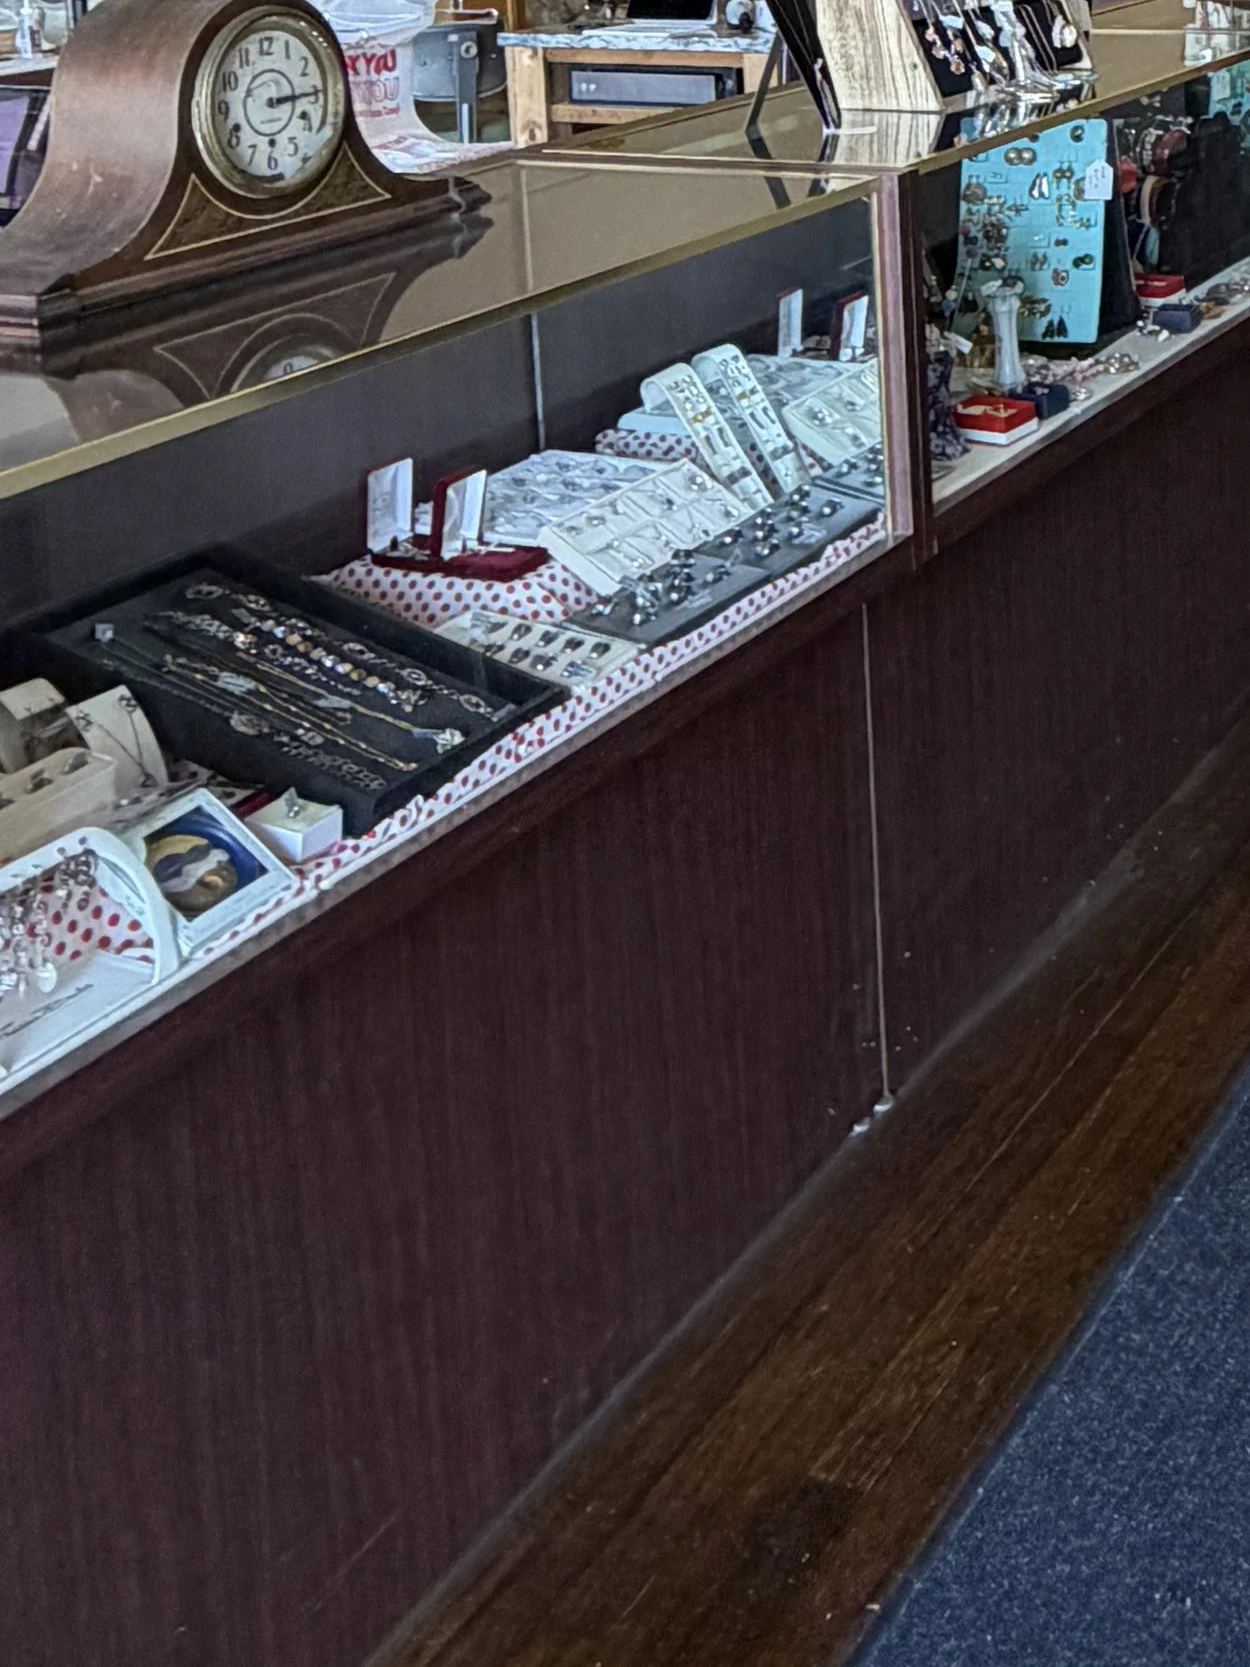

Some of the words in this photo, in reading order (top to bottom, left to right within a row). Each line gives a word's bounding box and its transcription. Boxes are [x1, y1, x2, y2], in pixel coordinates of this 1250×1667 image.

[240, 46, 250, 69] 11
[259, 36, 274, 57] 12
[284, 39, 291, 61] 1
[299, 56, 309, 77] 2
[222, 70, 239, 94] 10
[308, 84, 320, 105] 3
[218, 99, 230, 123] 9
[228, 127, 240, 150] 8
[287, 136, 299, 157] 5
[246, 143, 258, 166] 7
[267, 149, 279, 171] 6
